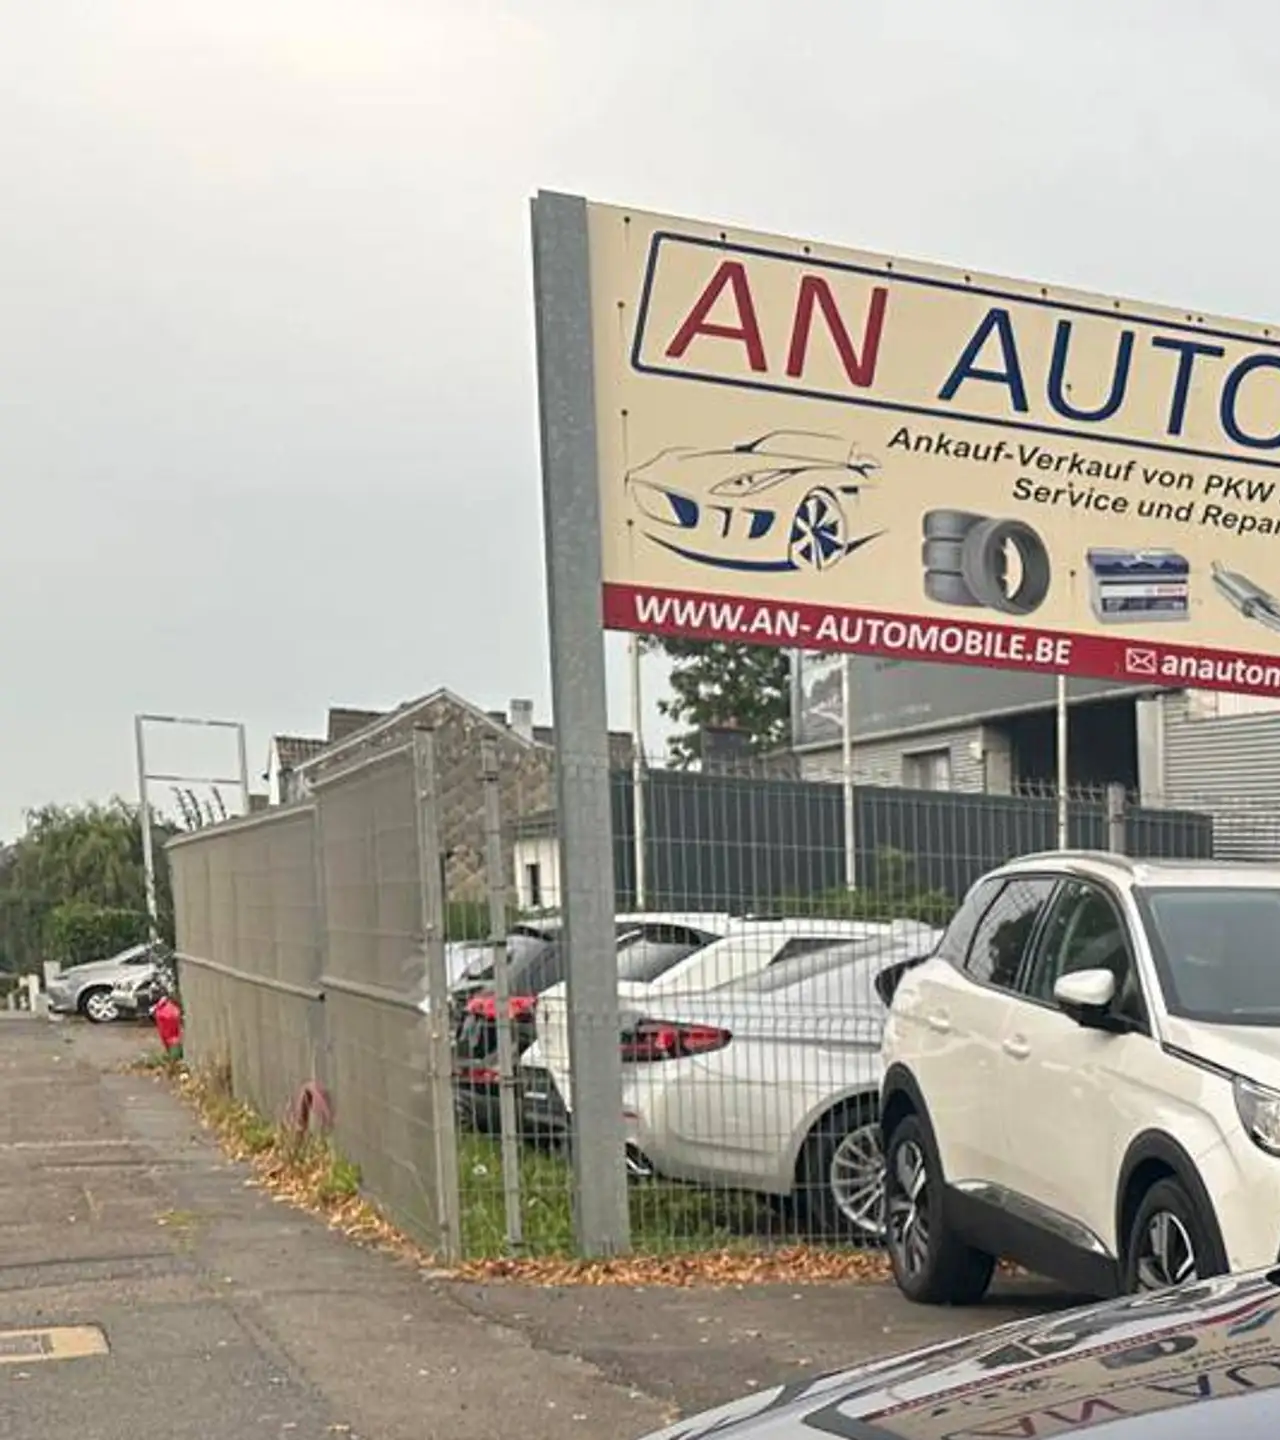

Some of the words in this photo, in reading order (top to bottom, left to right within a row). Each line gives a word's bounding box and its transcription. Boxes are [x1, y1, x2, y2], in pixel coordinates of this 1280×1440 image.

[664, 260, 889, 389] AN
[887, 427, 1137, 482] Ankauf-Verkauf
[1142, 468, 1194, 490] von
[1204, 474, 1275, 502] PKW
[1012, 477, 1129, 513] Service
[1137, 501, 1194, 523] und
